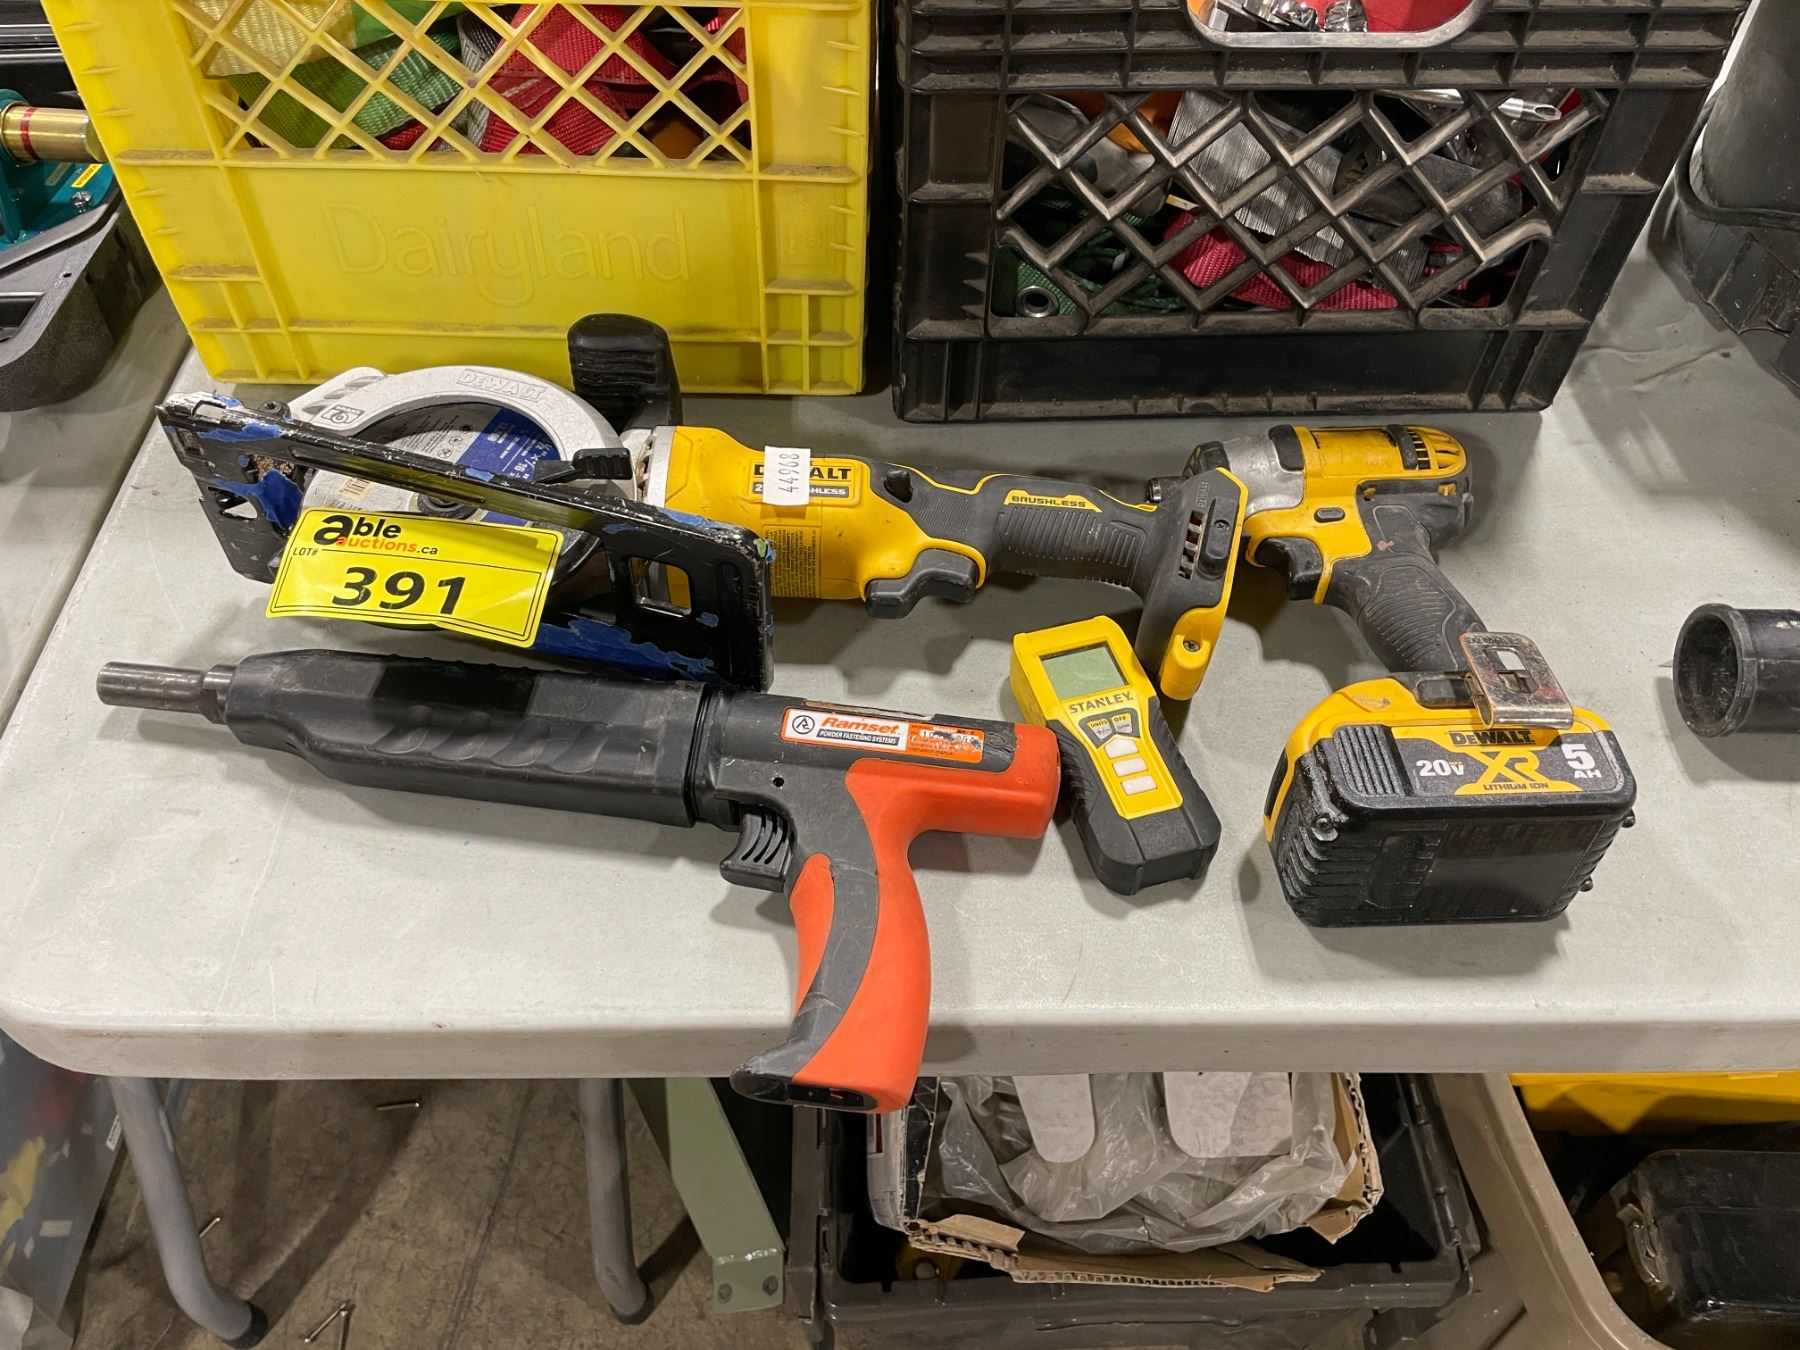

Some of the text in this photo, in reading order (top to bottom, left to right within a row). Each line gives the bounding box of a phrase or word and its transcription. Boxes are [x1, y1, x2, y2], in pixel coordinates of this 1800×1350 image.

[322, 202, 692, 308] Dairyland
[754, 463, 852, 480] DALT
[778, 453, 800, 493] 44968
[1012, 495, 1086, 507] BRUSHLESS
[313, 514, 402, 546] able
[292, 547, 319, 557] LOT#
[336, 535, 439, 555] auctions.ca
[332, 566, 466, 615] 391
[1069, 691, 1131, 714] STANLEY
[820, 717, 899, 735] Ramset
[820, 730, 897, 745] POWDER FASTENING SYSTEMS
[1464, 750, 1553, 784] XR
[1561, 743, 1596, 771] 5
[1573, 769, 1603, 779] AH
[1483, 782, 1549, 791] LITHIUM ION
